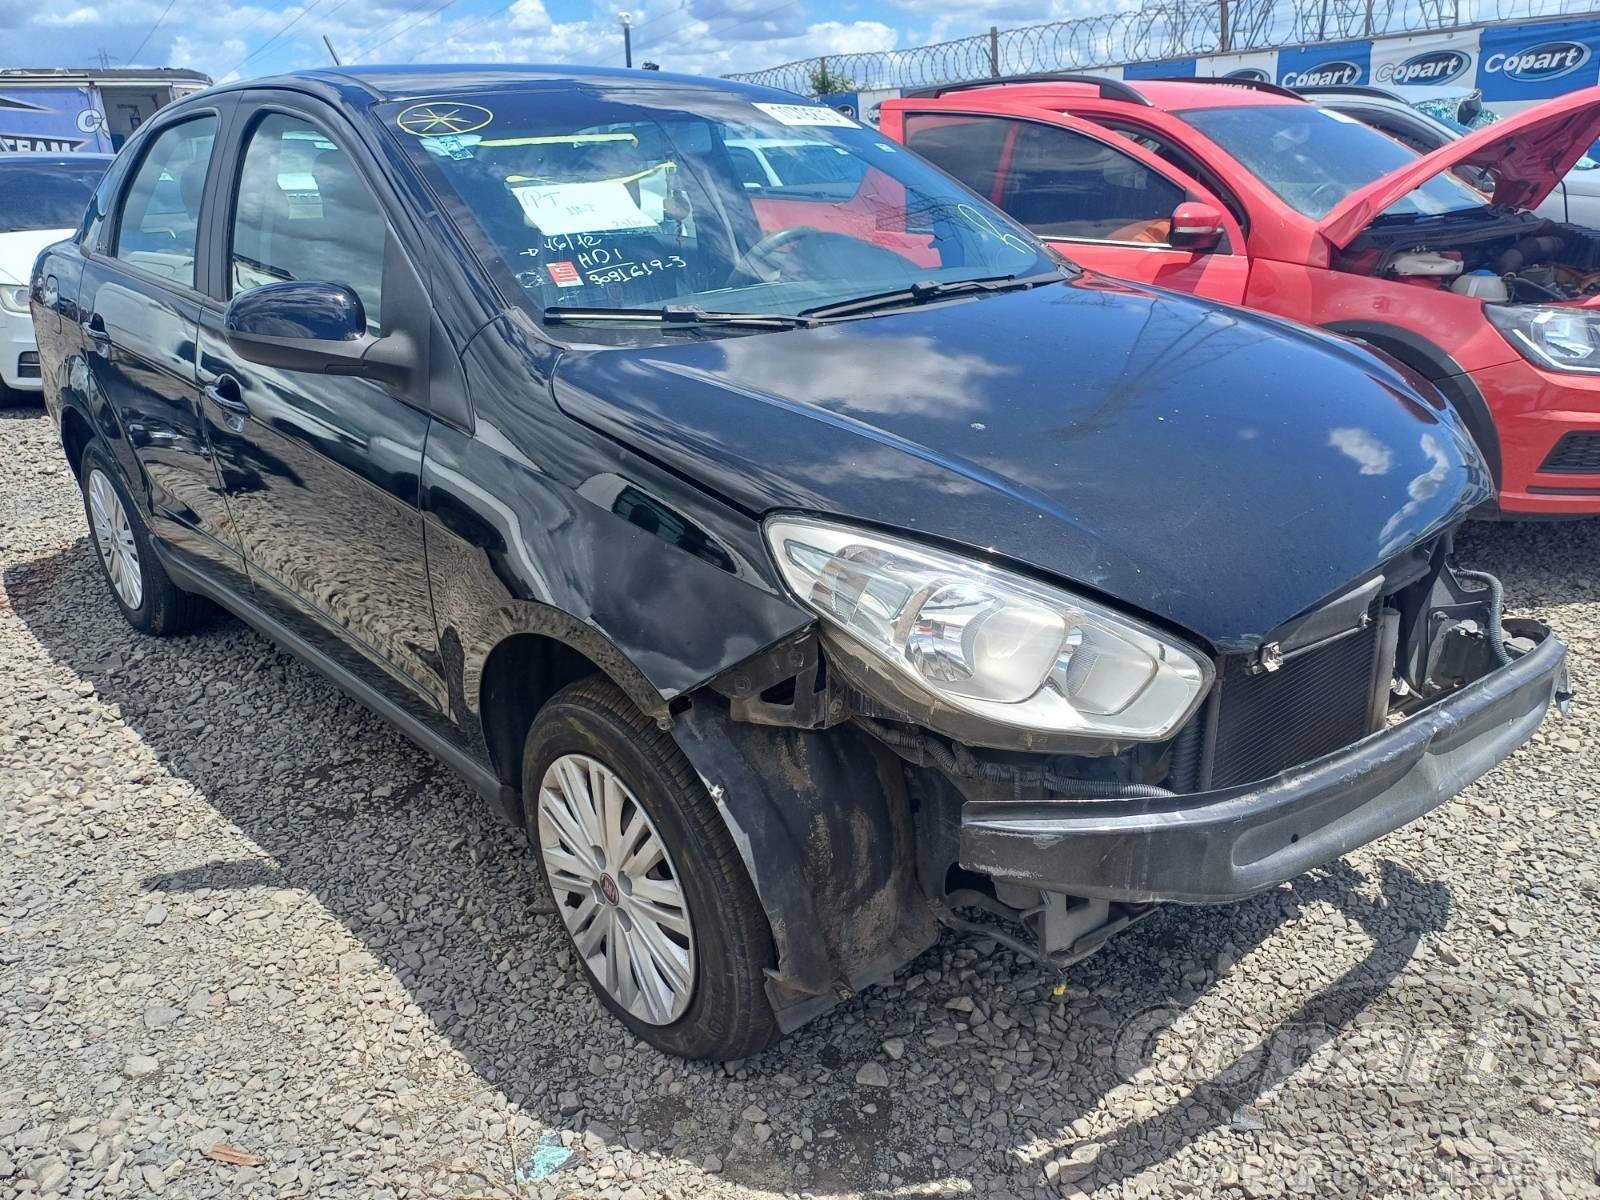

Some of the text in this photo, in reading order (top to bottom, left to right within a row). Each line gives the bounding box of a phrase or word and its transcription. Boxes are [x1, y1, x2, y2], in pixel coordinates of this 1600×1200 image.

[1375, 56, 1459, 83] Copart
[1485, 47, 1578, 75] Copart
[1282, 66, 1352, 87] Copart
